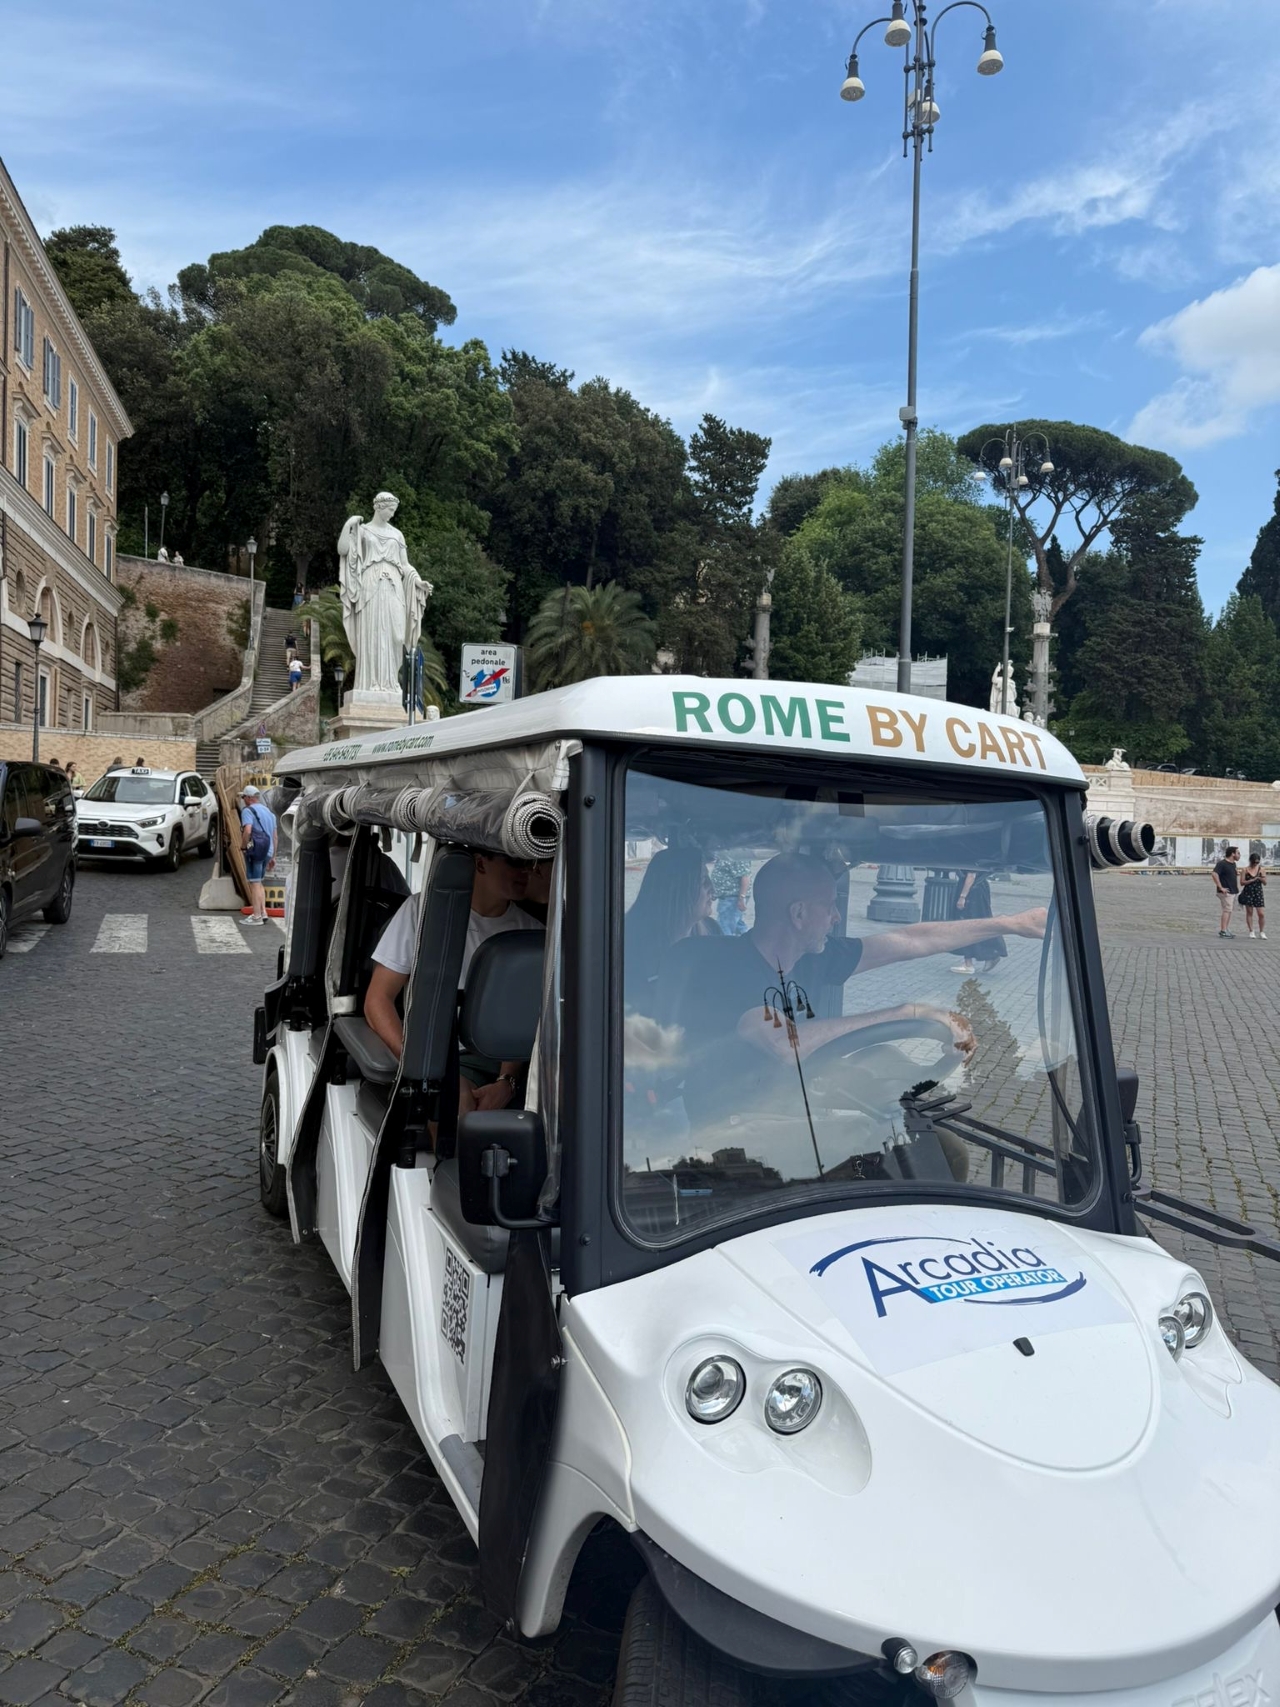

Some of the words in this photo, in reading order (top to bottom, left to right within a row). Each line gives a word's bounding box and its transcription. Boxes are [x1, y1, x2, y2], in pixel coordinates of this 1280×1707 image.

[471, 658, 506, 666] pedonale
[673, 692, 850, 742] ROME
[866, 705, 926, 752] BY
[945, 717, 1047, 771] CART
[861, 1238, 1047, 1318] Arcadia
[929, 1279, 981, 1300] TOUR
[985, 1268, 1064, 1291] OPERATOR
